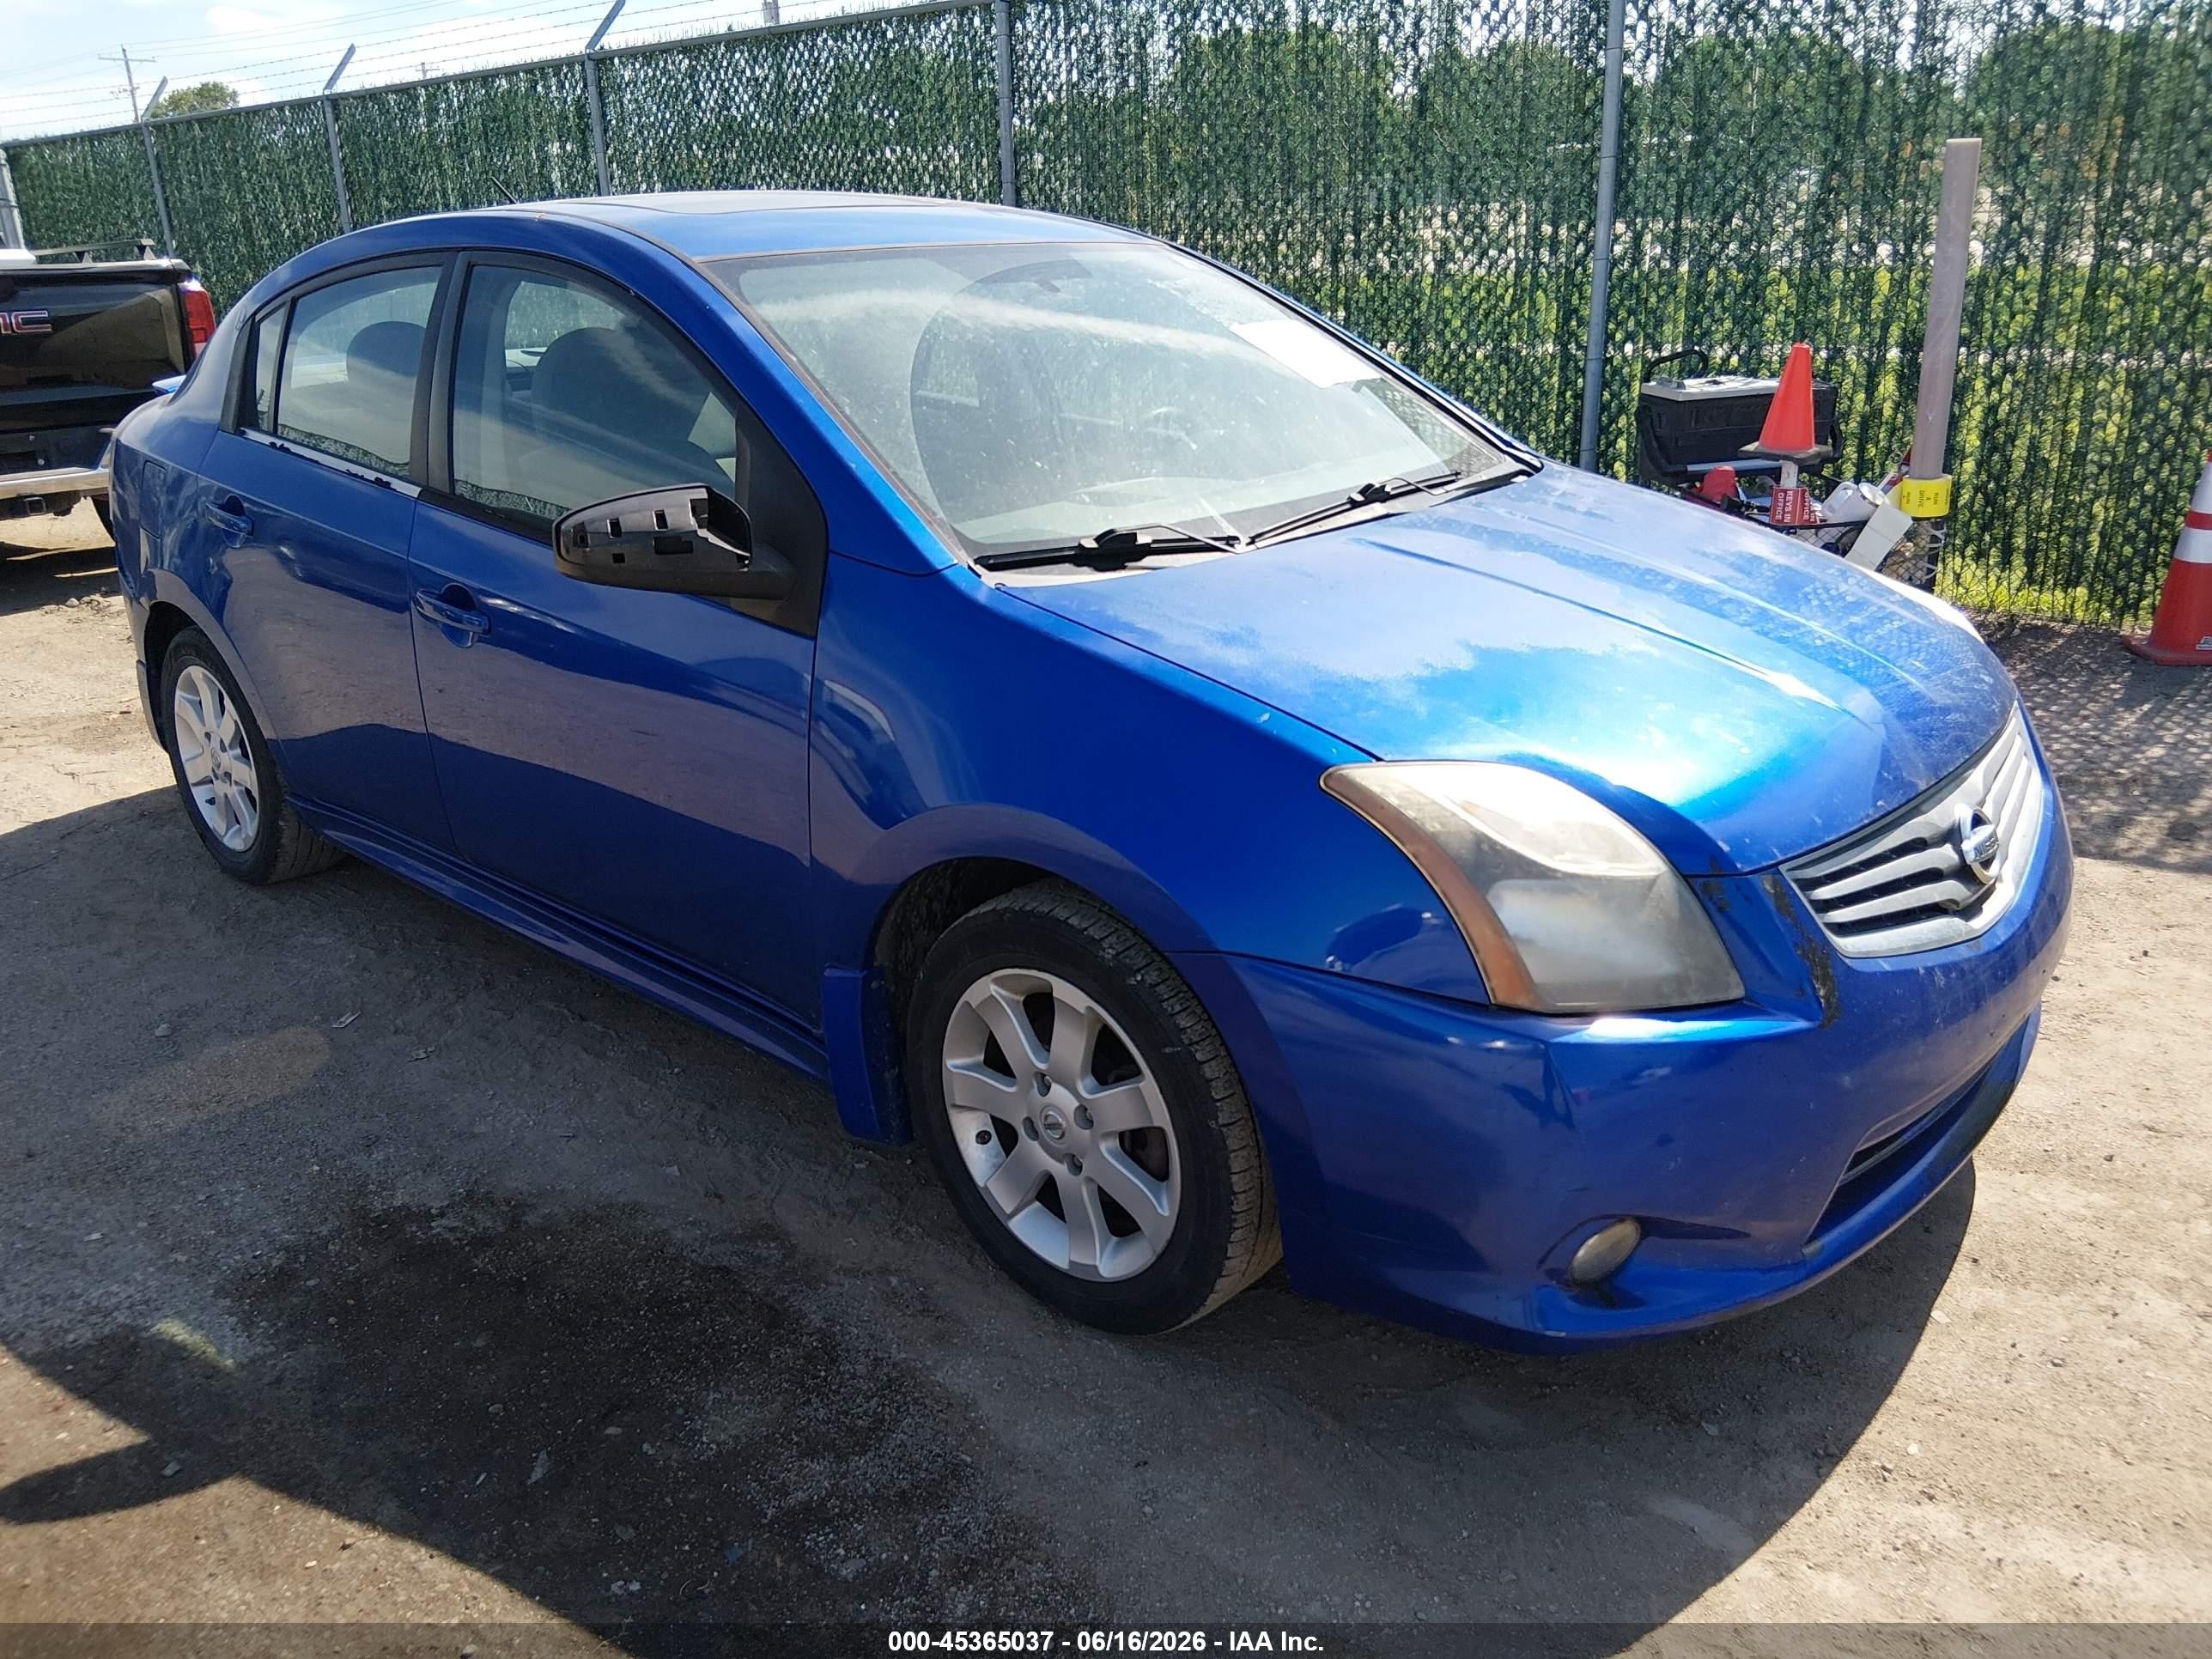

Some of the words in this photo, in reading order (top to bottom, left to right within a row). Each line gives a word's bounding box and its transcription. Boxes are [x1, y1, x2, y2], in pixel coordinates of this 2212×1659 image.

[1775, 492, 1784, 520] OFFICE
[1784, 490, 1794, 512] KEYS
[1784, 514, 1792, 523] IN
